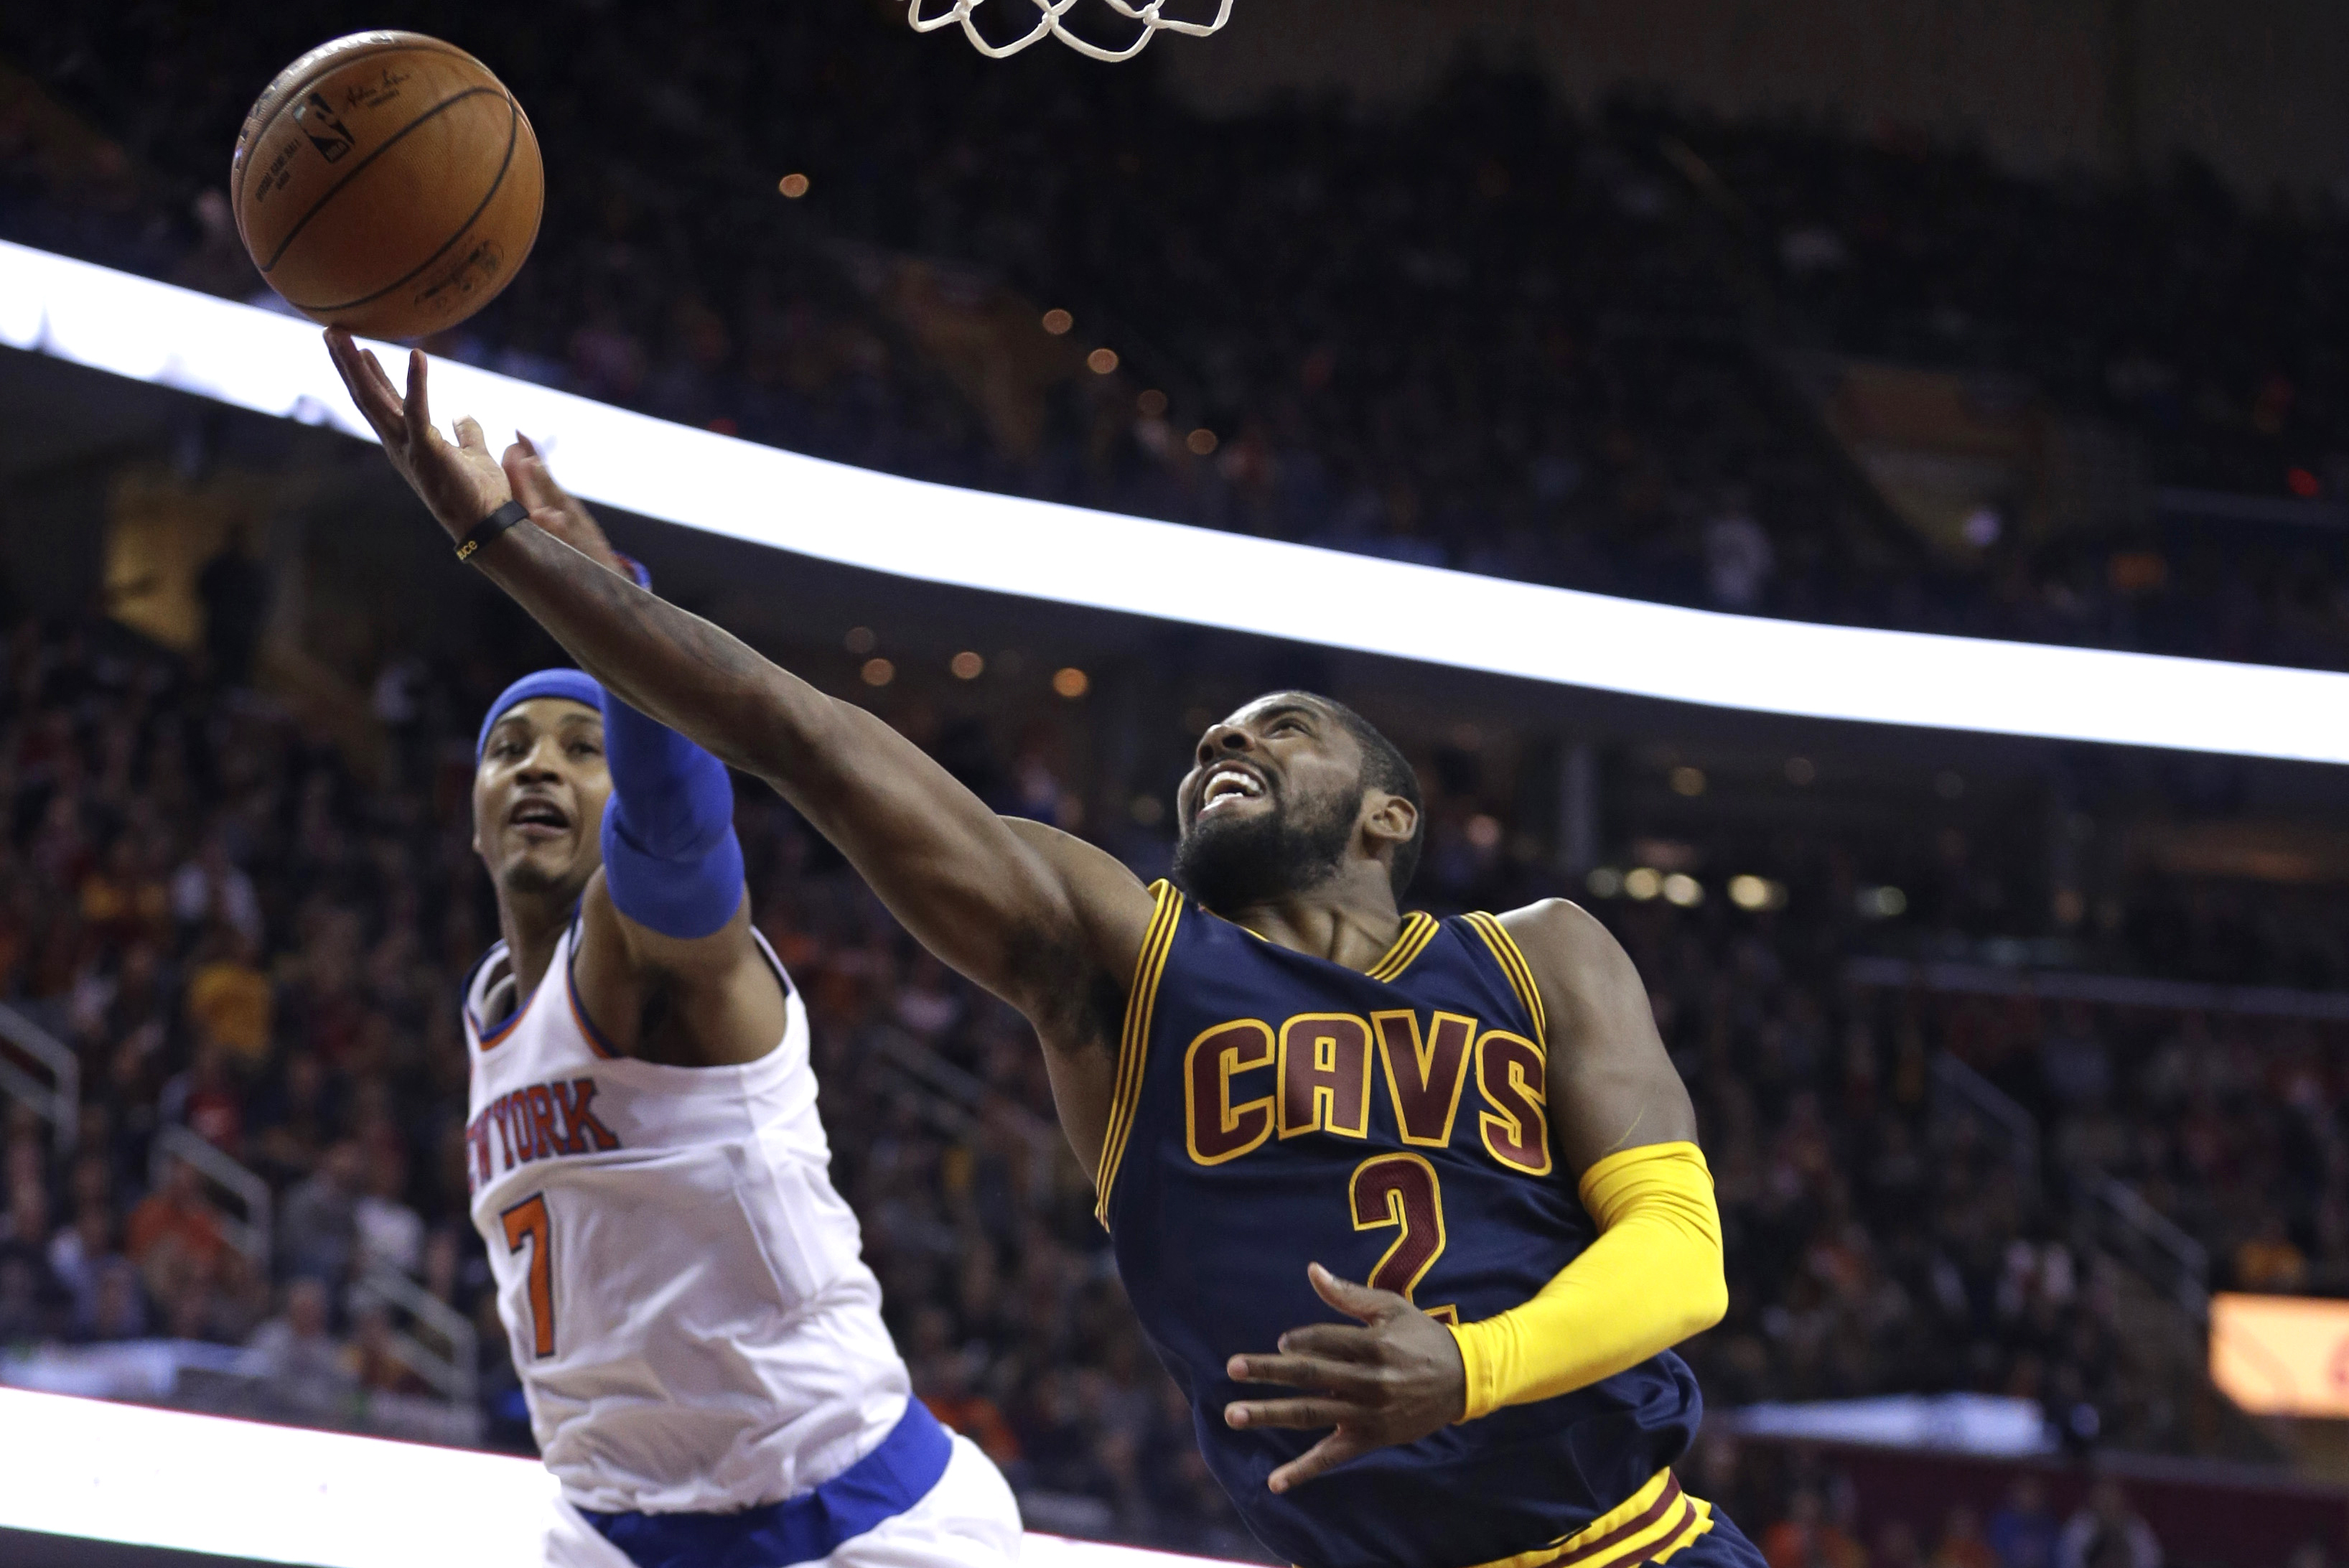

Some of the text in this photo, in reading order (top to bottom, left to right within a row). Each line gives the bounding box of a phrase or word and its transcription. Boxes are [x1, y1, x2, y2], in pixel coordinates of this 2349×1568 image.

[1185, 1009, 1551, 1176] CAVS
[500, 1192, 555, 1359] 7
[1348, 1152, 1458, 1325] 2
